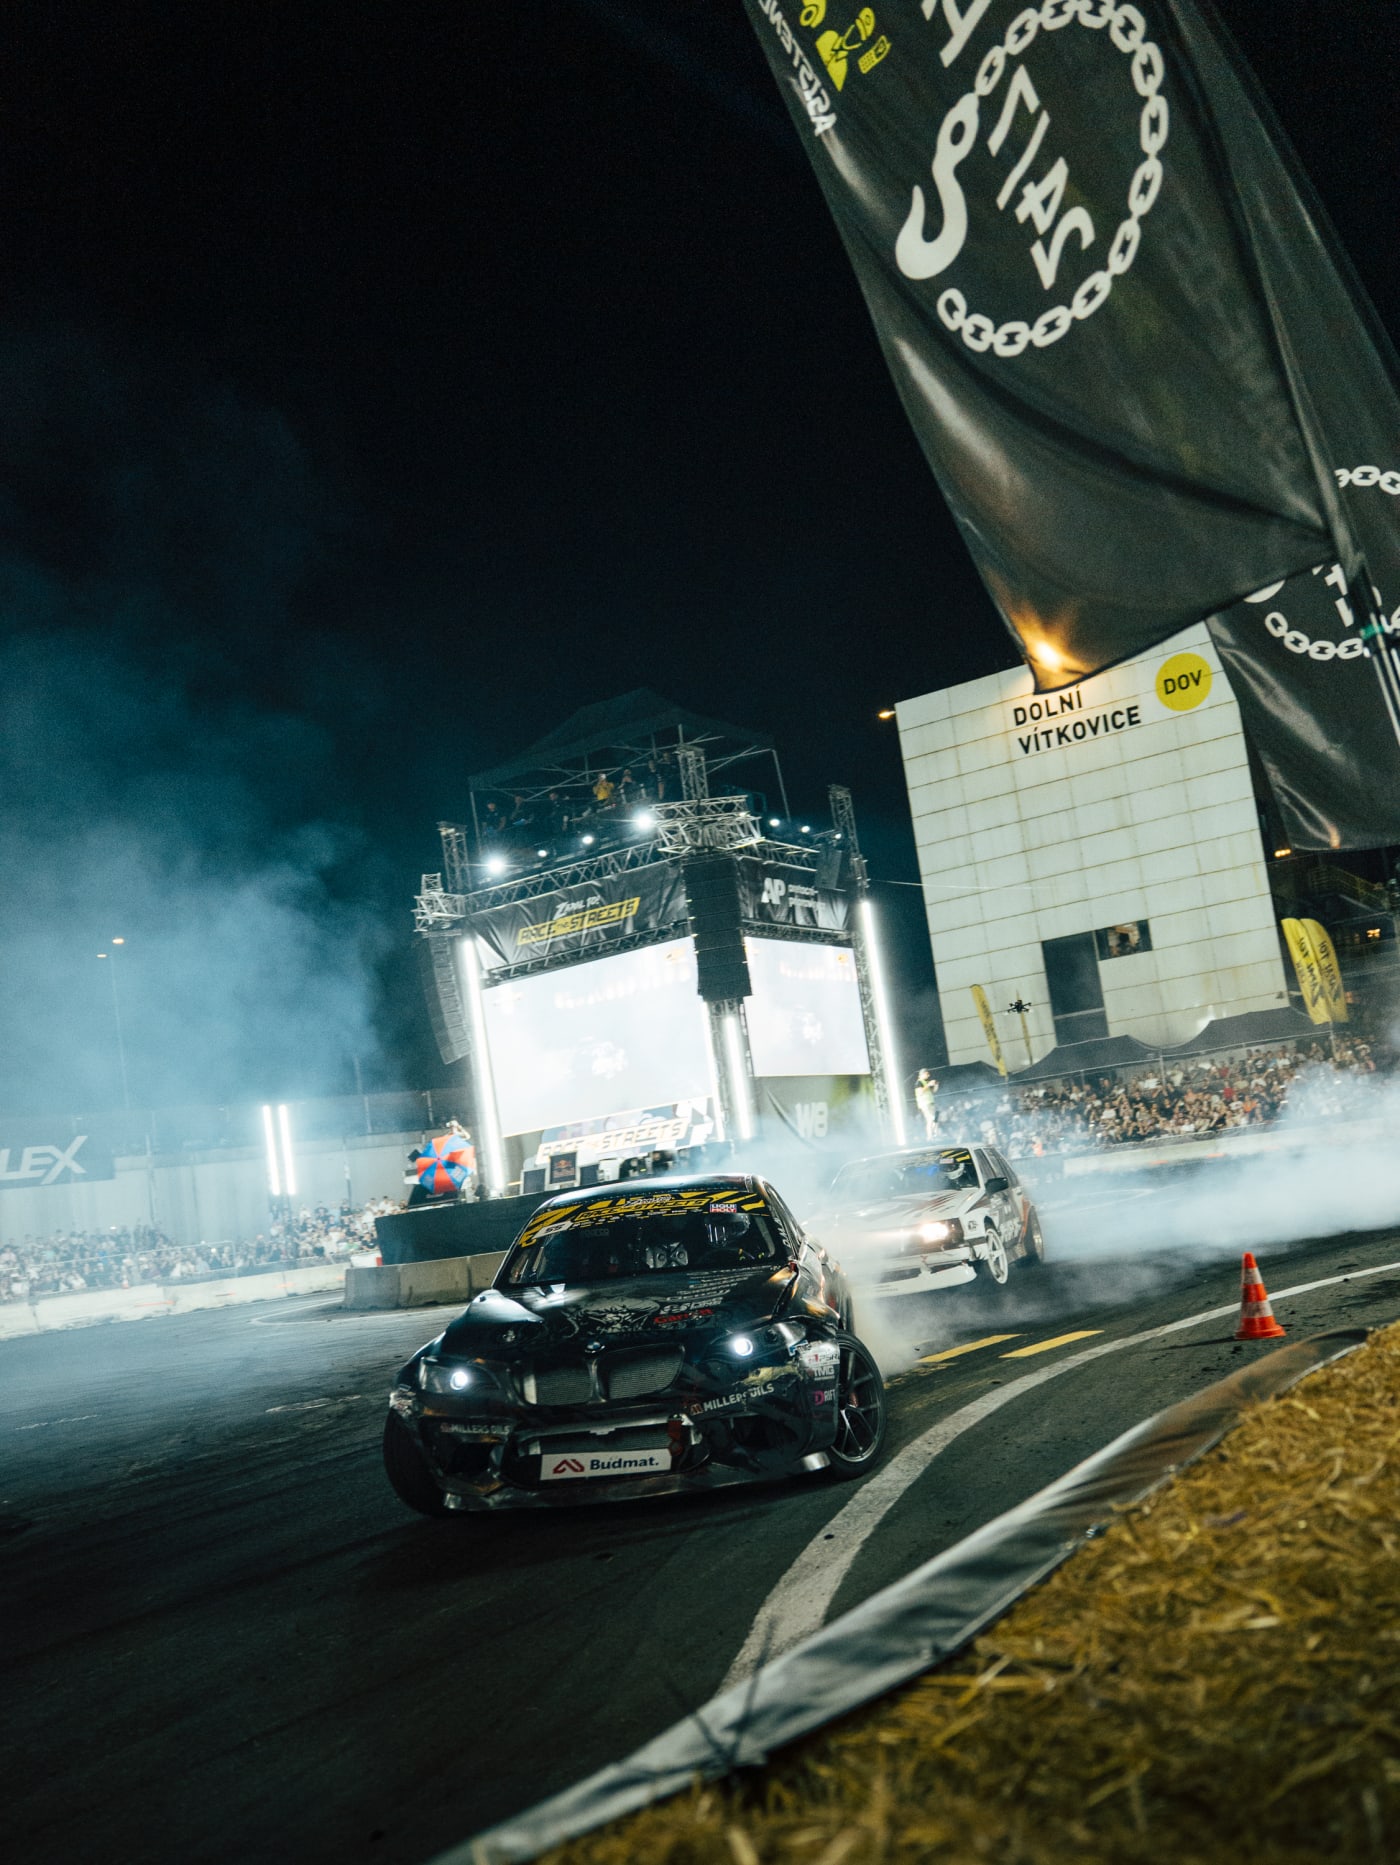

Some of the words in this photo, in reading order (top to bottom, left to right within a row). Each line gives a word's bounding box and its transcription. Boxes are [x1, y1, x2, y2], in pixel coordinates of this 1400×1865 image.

[1163, 669, 1202, 695] DOV
[1013, 684, 1083, 726] DOLNÍ
[1018, 704, 1142, 754] VÍTKOVICE
[589, 1456, 660, 1471] Budmat.
